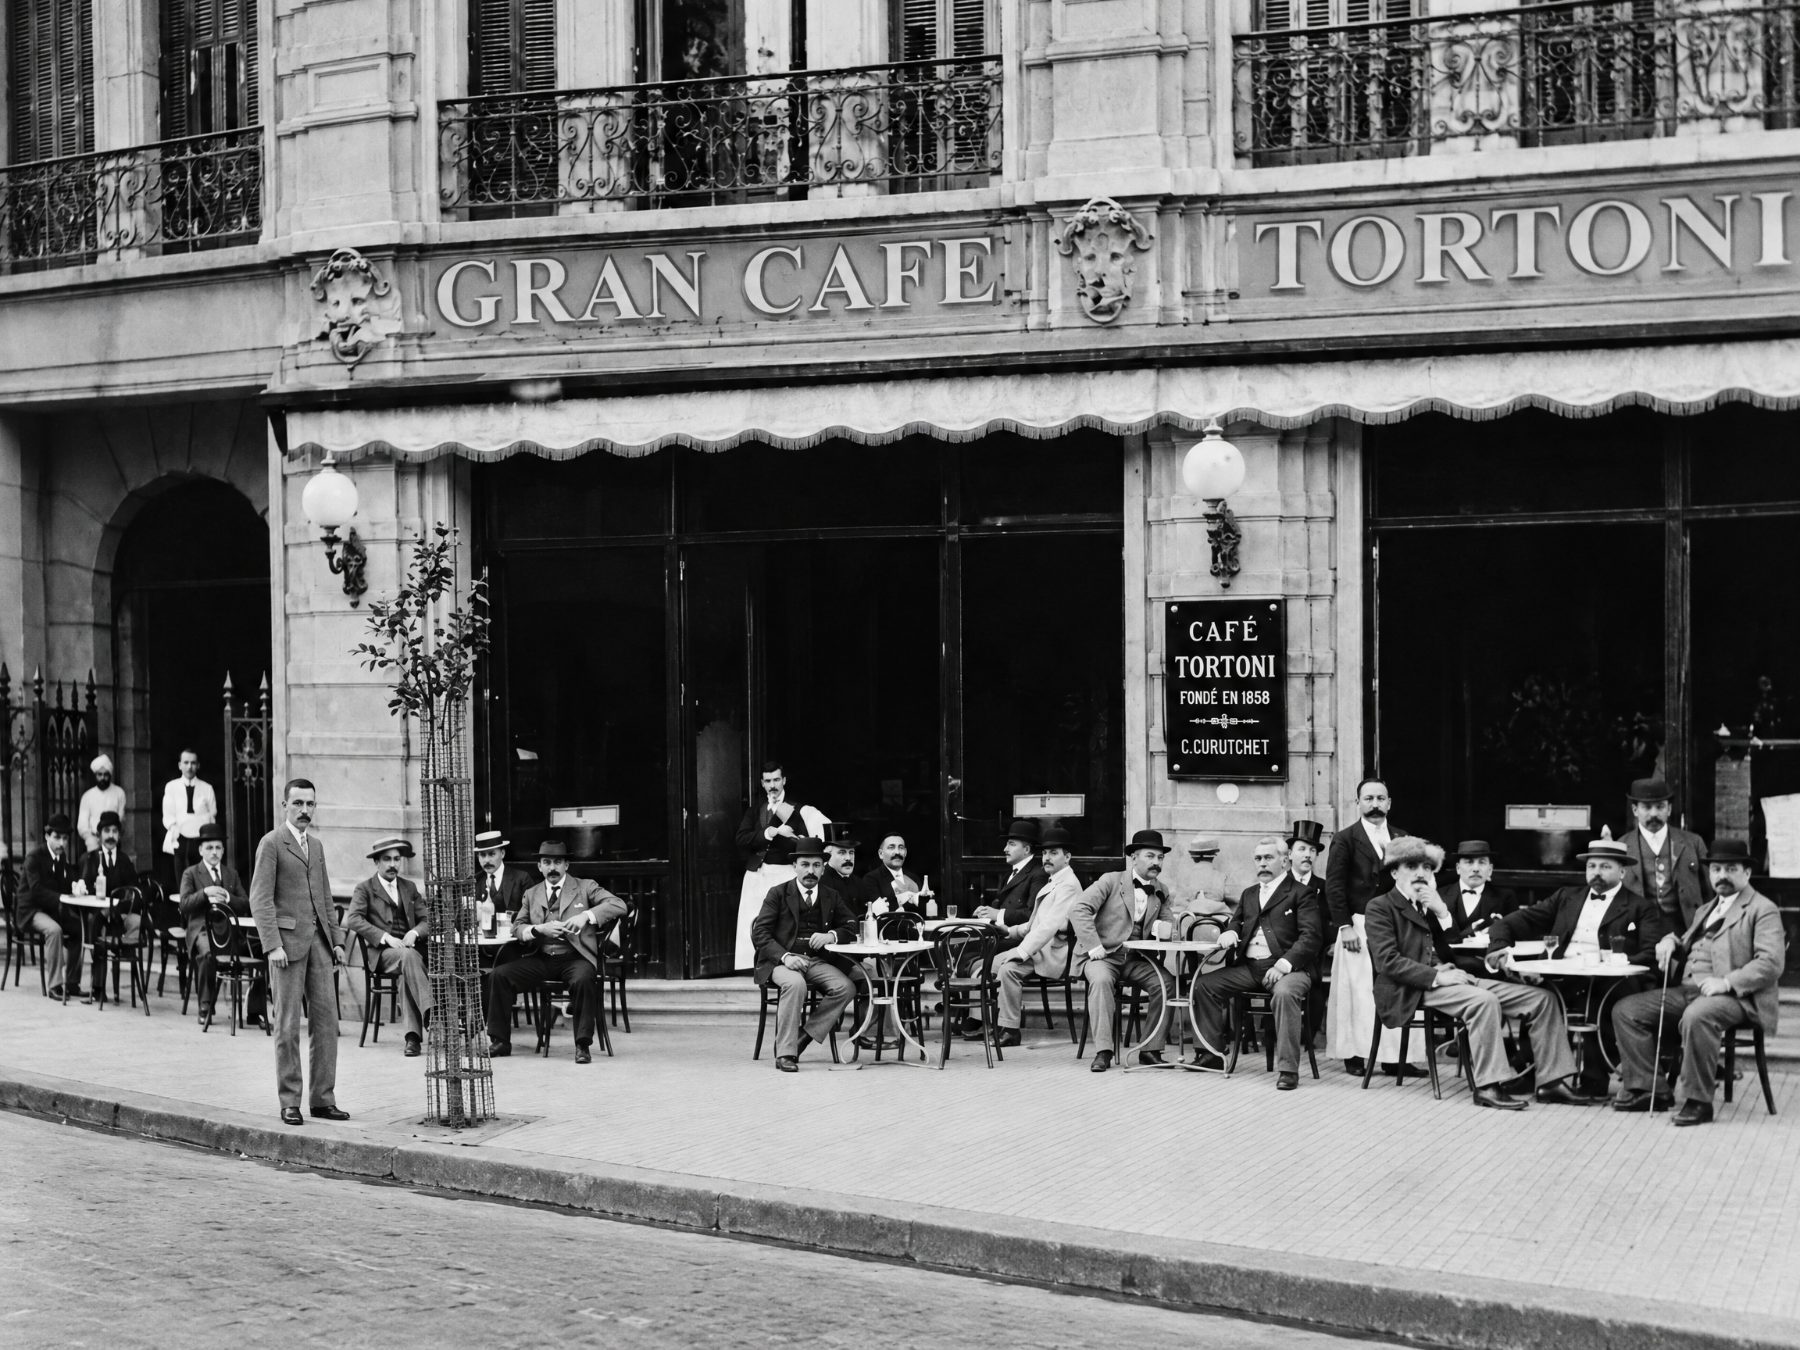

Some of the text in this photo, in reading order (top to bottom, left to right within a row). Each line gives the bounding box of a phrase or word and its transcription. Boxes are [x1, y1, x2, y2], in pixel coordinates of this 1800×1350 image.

[436, 191, 1794, 327] GRAN CAFE TORTONI
[1189, 616, 1258, 641] CAFÉ
[1175, 655, 1275, 678] TORTONI
[1180, 687, 1270, 705] FONDÉ EN 1858
